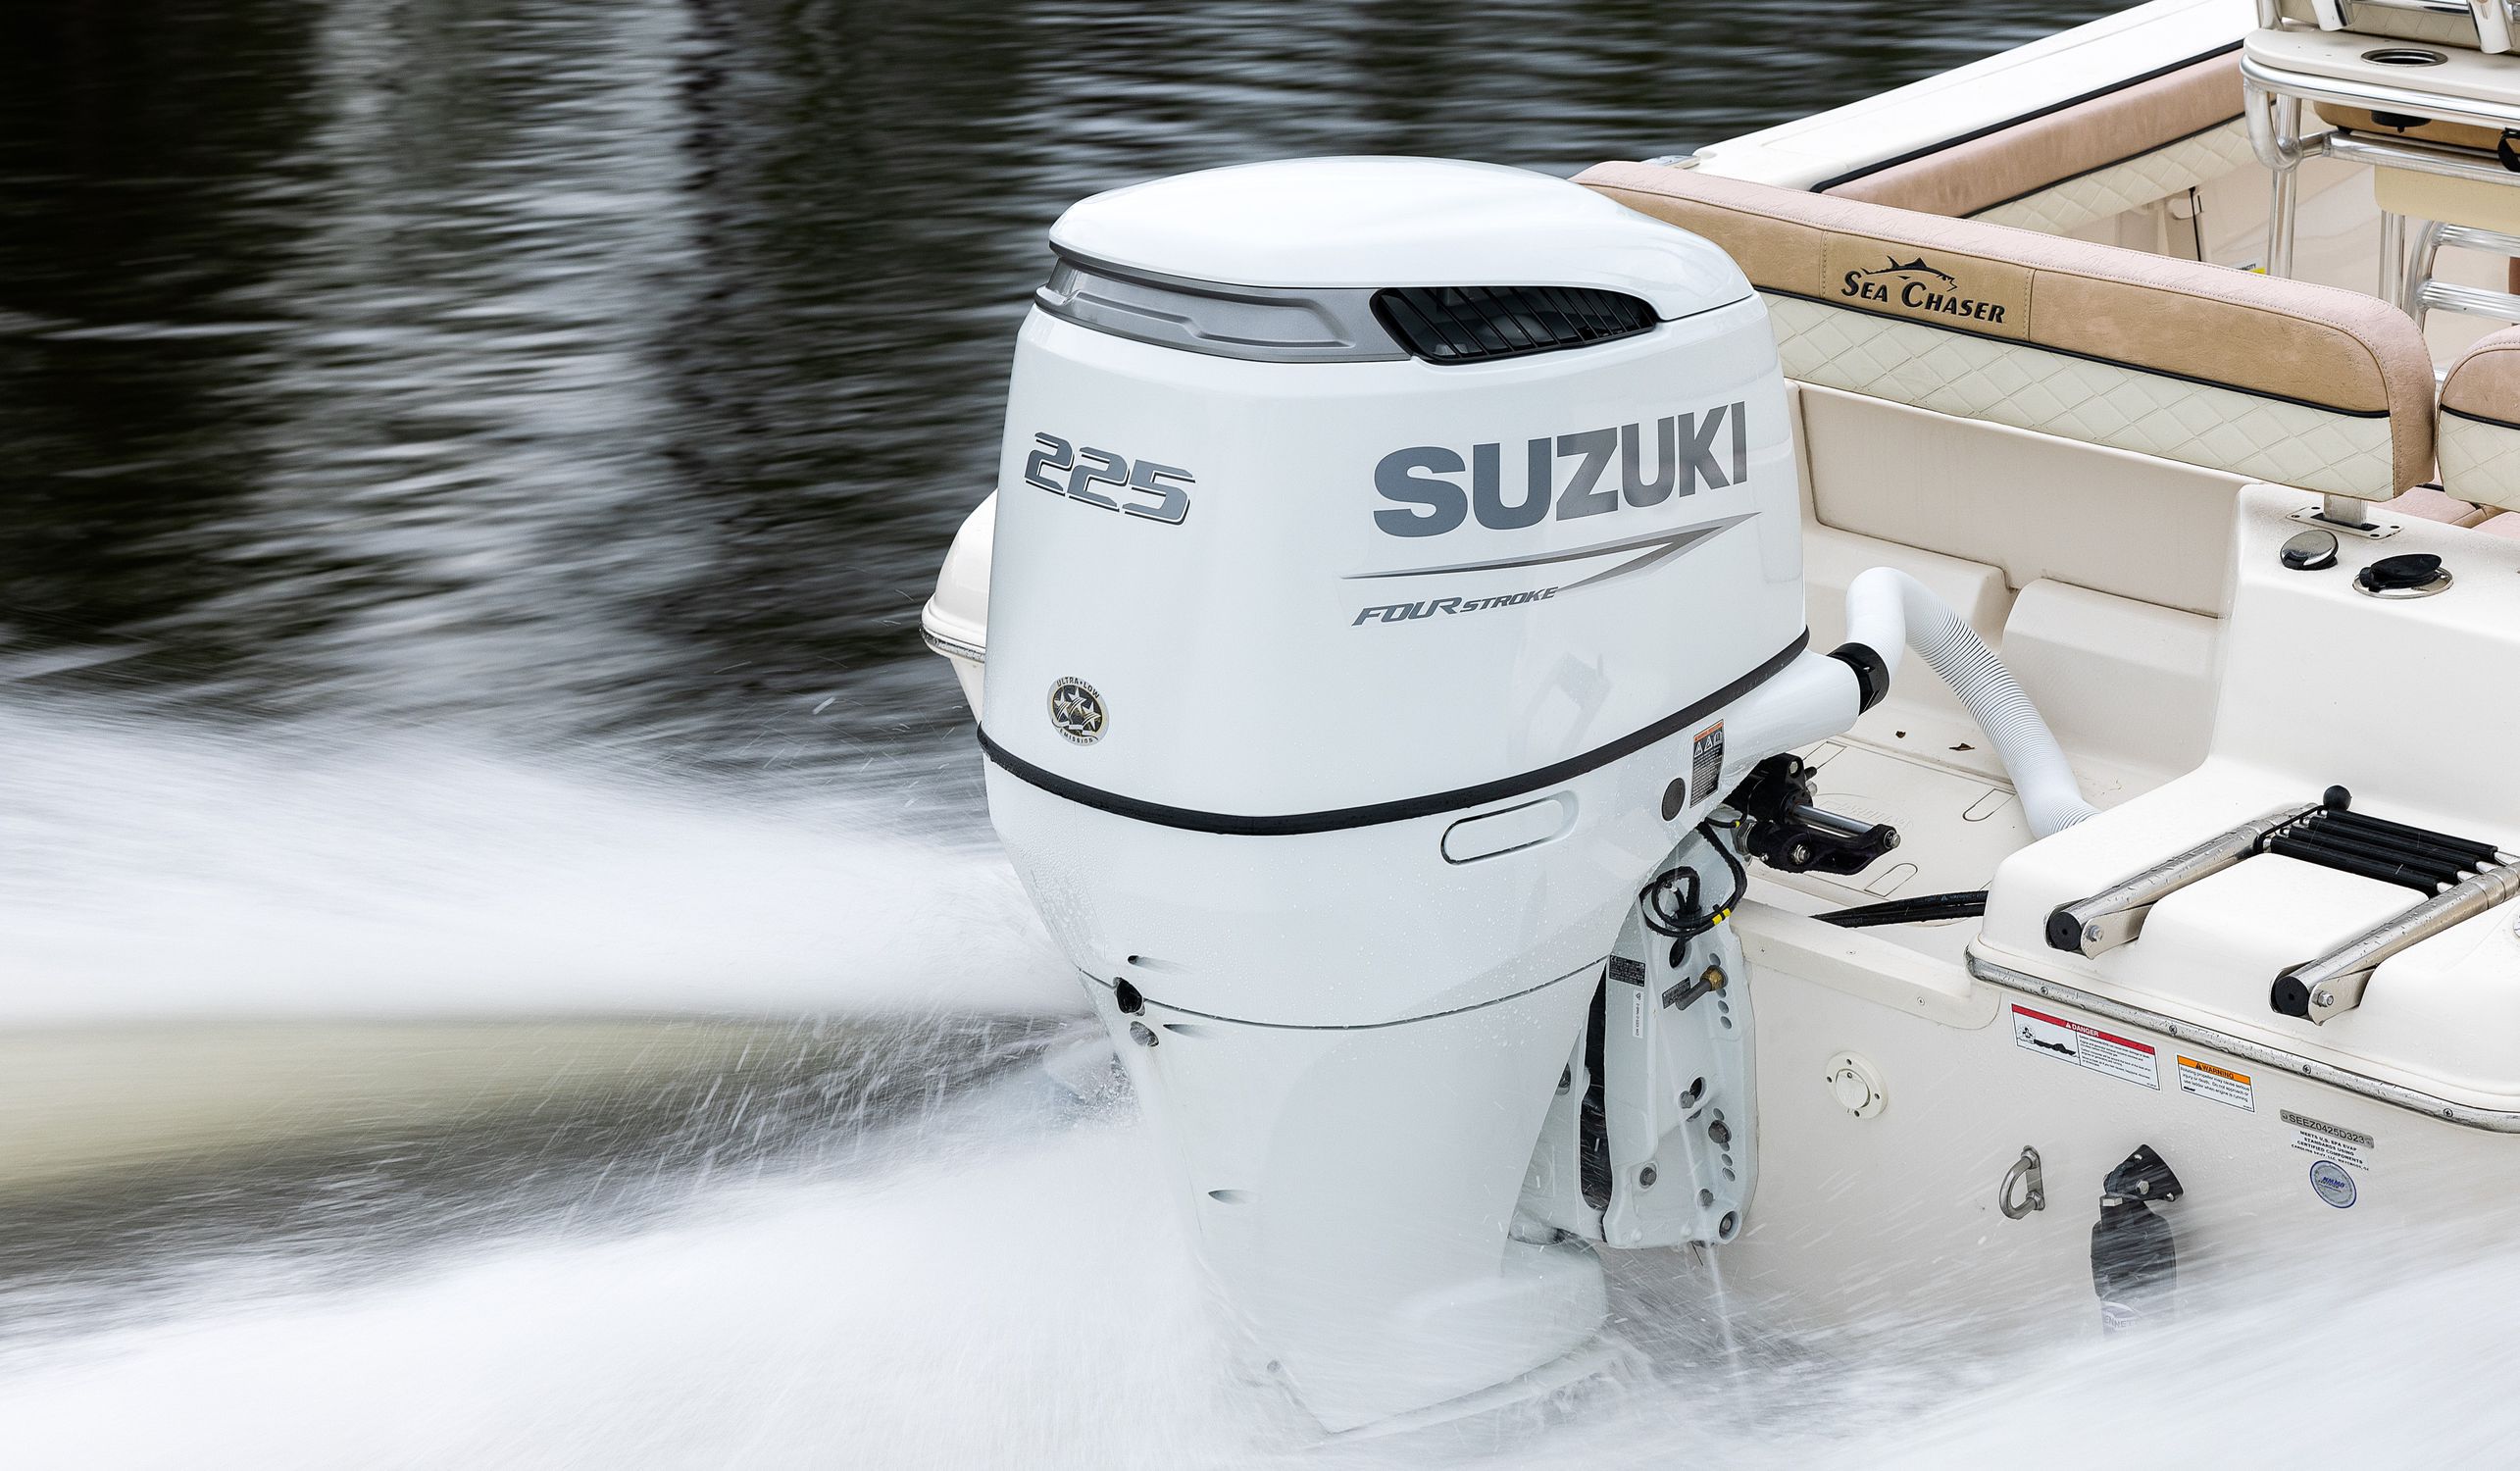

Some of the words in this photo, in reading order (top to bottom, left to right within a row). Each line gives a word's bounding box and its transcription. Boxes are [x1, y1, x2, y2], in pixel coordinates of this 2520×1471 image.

[1840, 270, 1889, 303] SEA
[1901, 280, 2006, 325] CHASER
[1024, 431, 1196, 528] 225
[1373, 400, 1748, 538] SUZUKI
[2071, 1024, 2099, 1038] DANGER
[2200, 1063, 2235, 1080] WARNING
[2289, 1114, 2364, 1143] SEEZ0425D323
